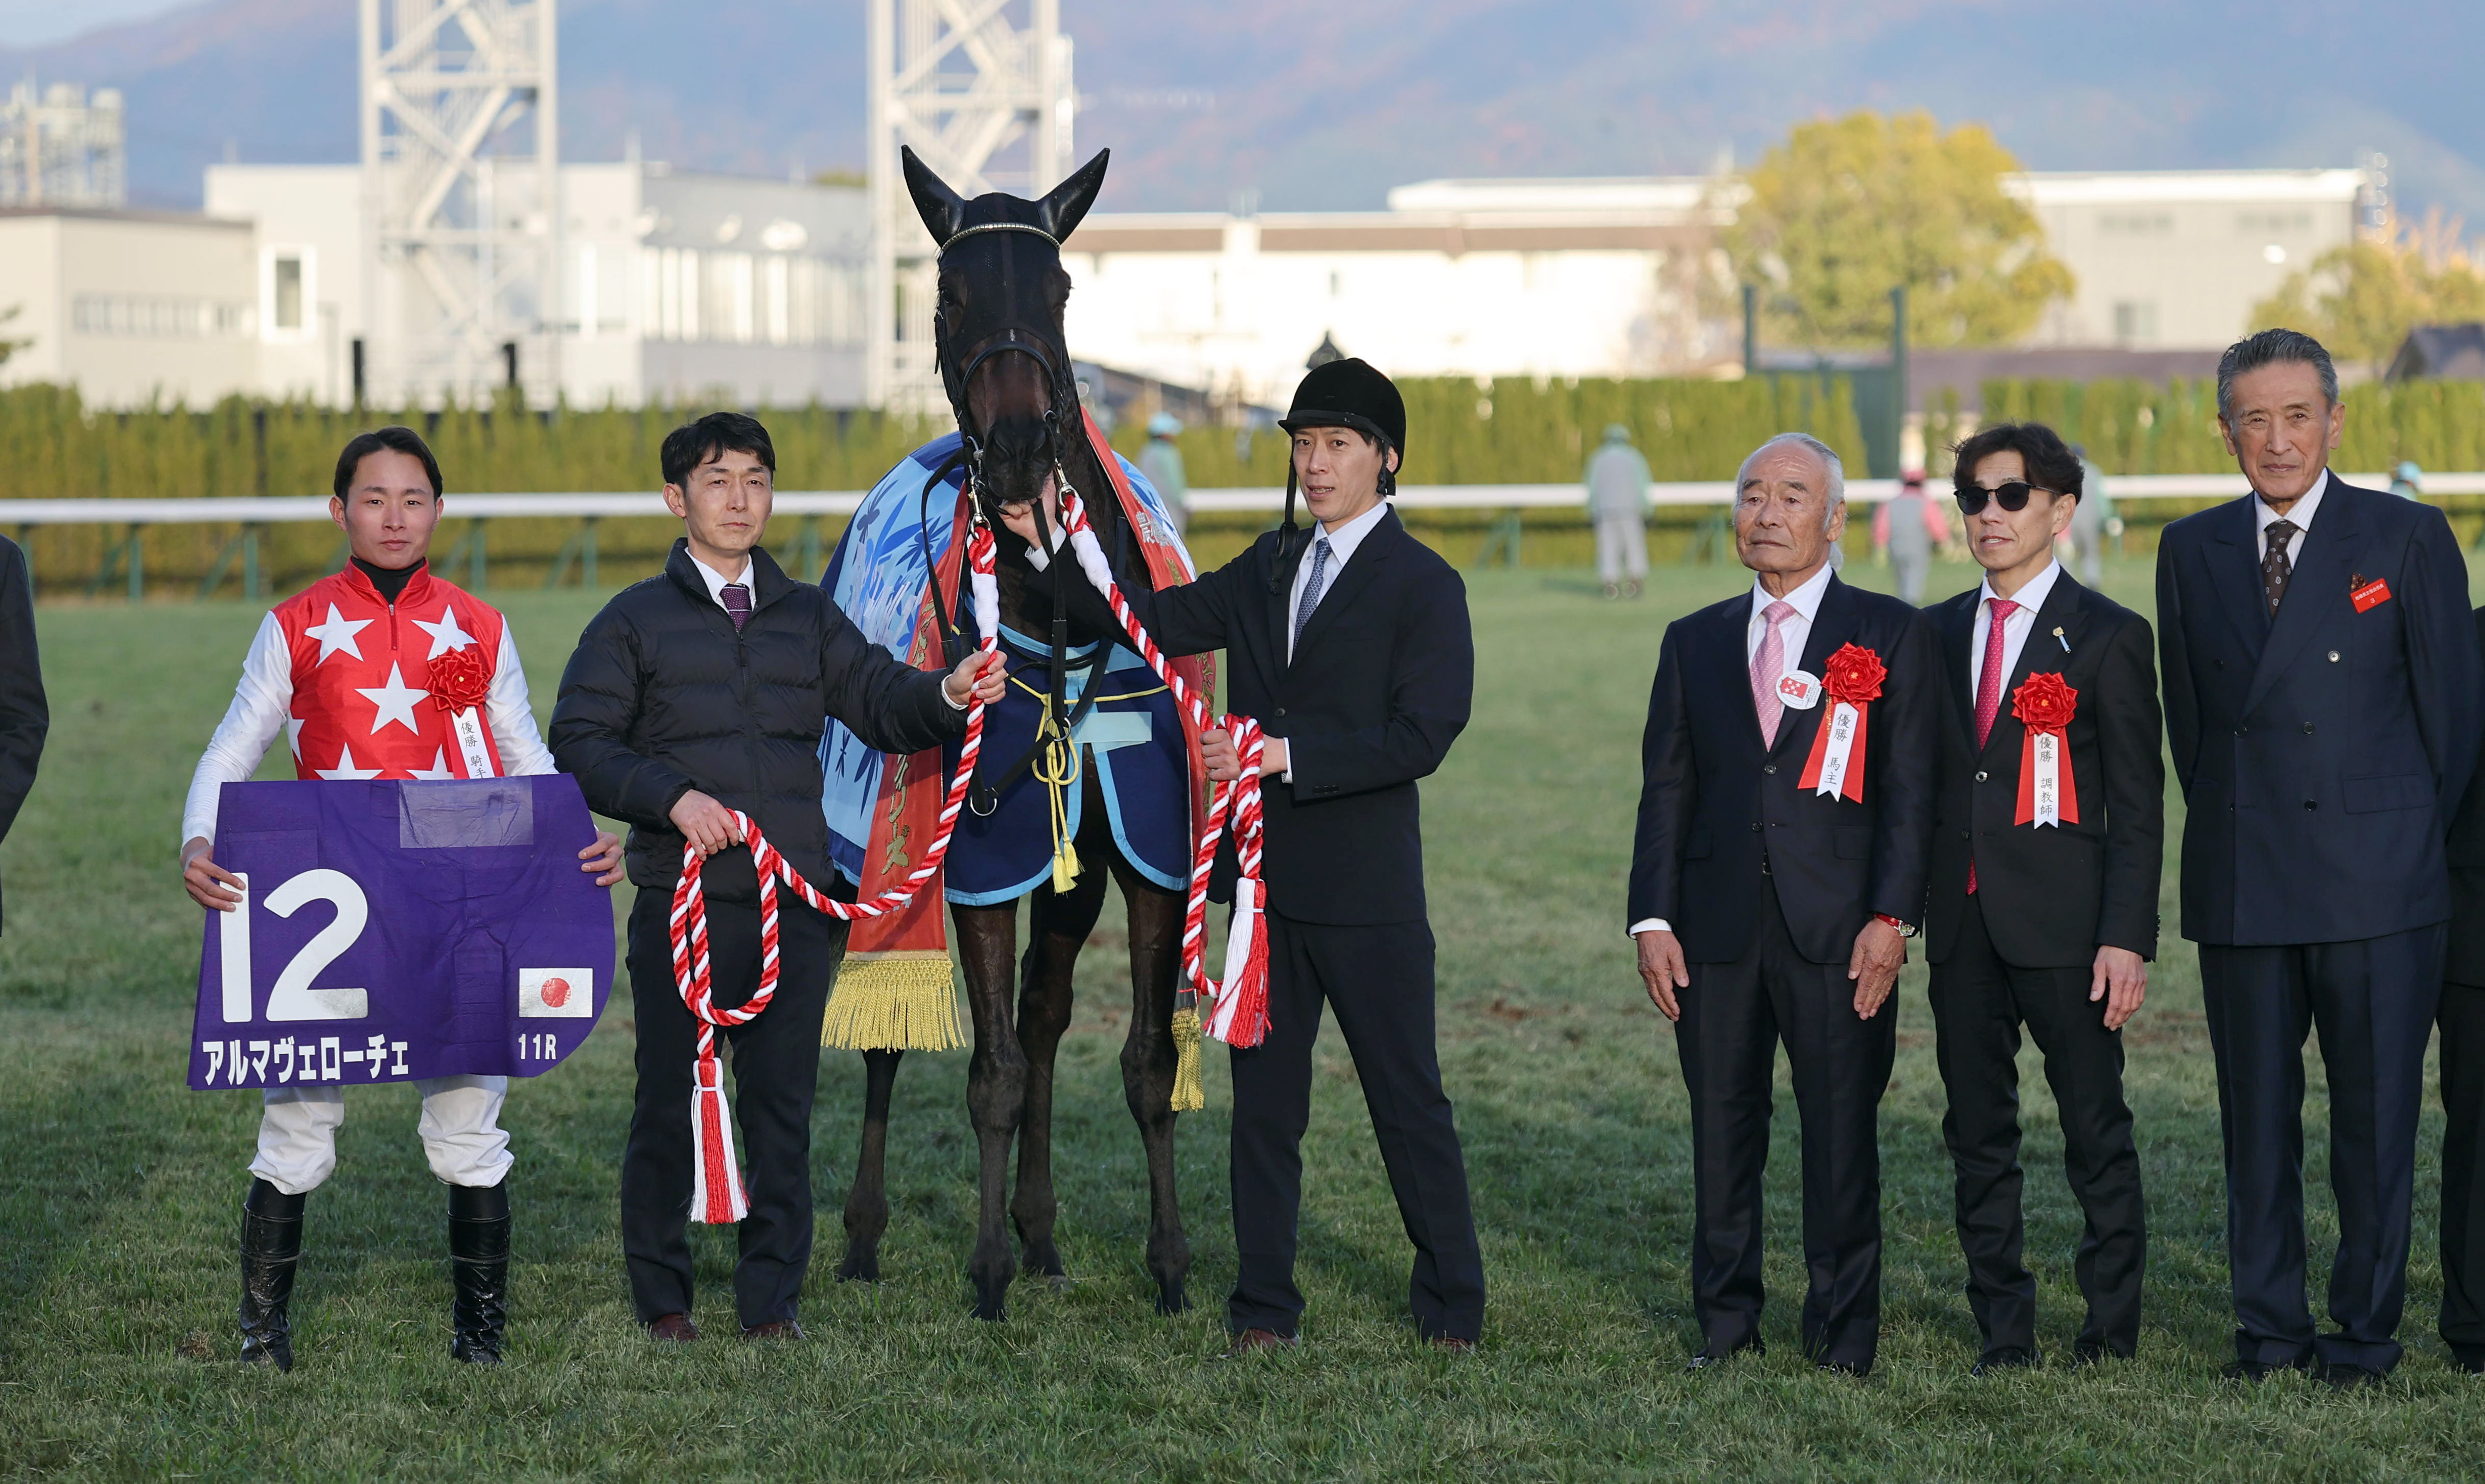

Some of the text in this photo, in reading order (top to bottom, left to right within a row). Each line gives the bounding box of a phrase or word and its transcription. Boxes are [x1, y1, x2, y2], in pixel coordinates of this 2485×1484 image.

[461, 721, 486, 779] 優勝 騎手
[1824, 713, 1850, 785] 優勝 馬主
[2039, 736, 2053, 817] 優勝 調教師
[220, 868, 368, 1023] 12
[202, 1033, 409, 1086] アルマヴェローチェ
[518, 1033, 557, 1061] 11R
